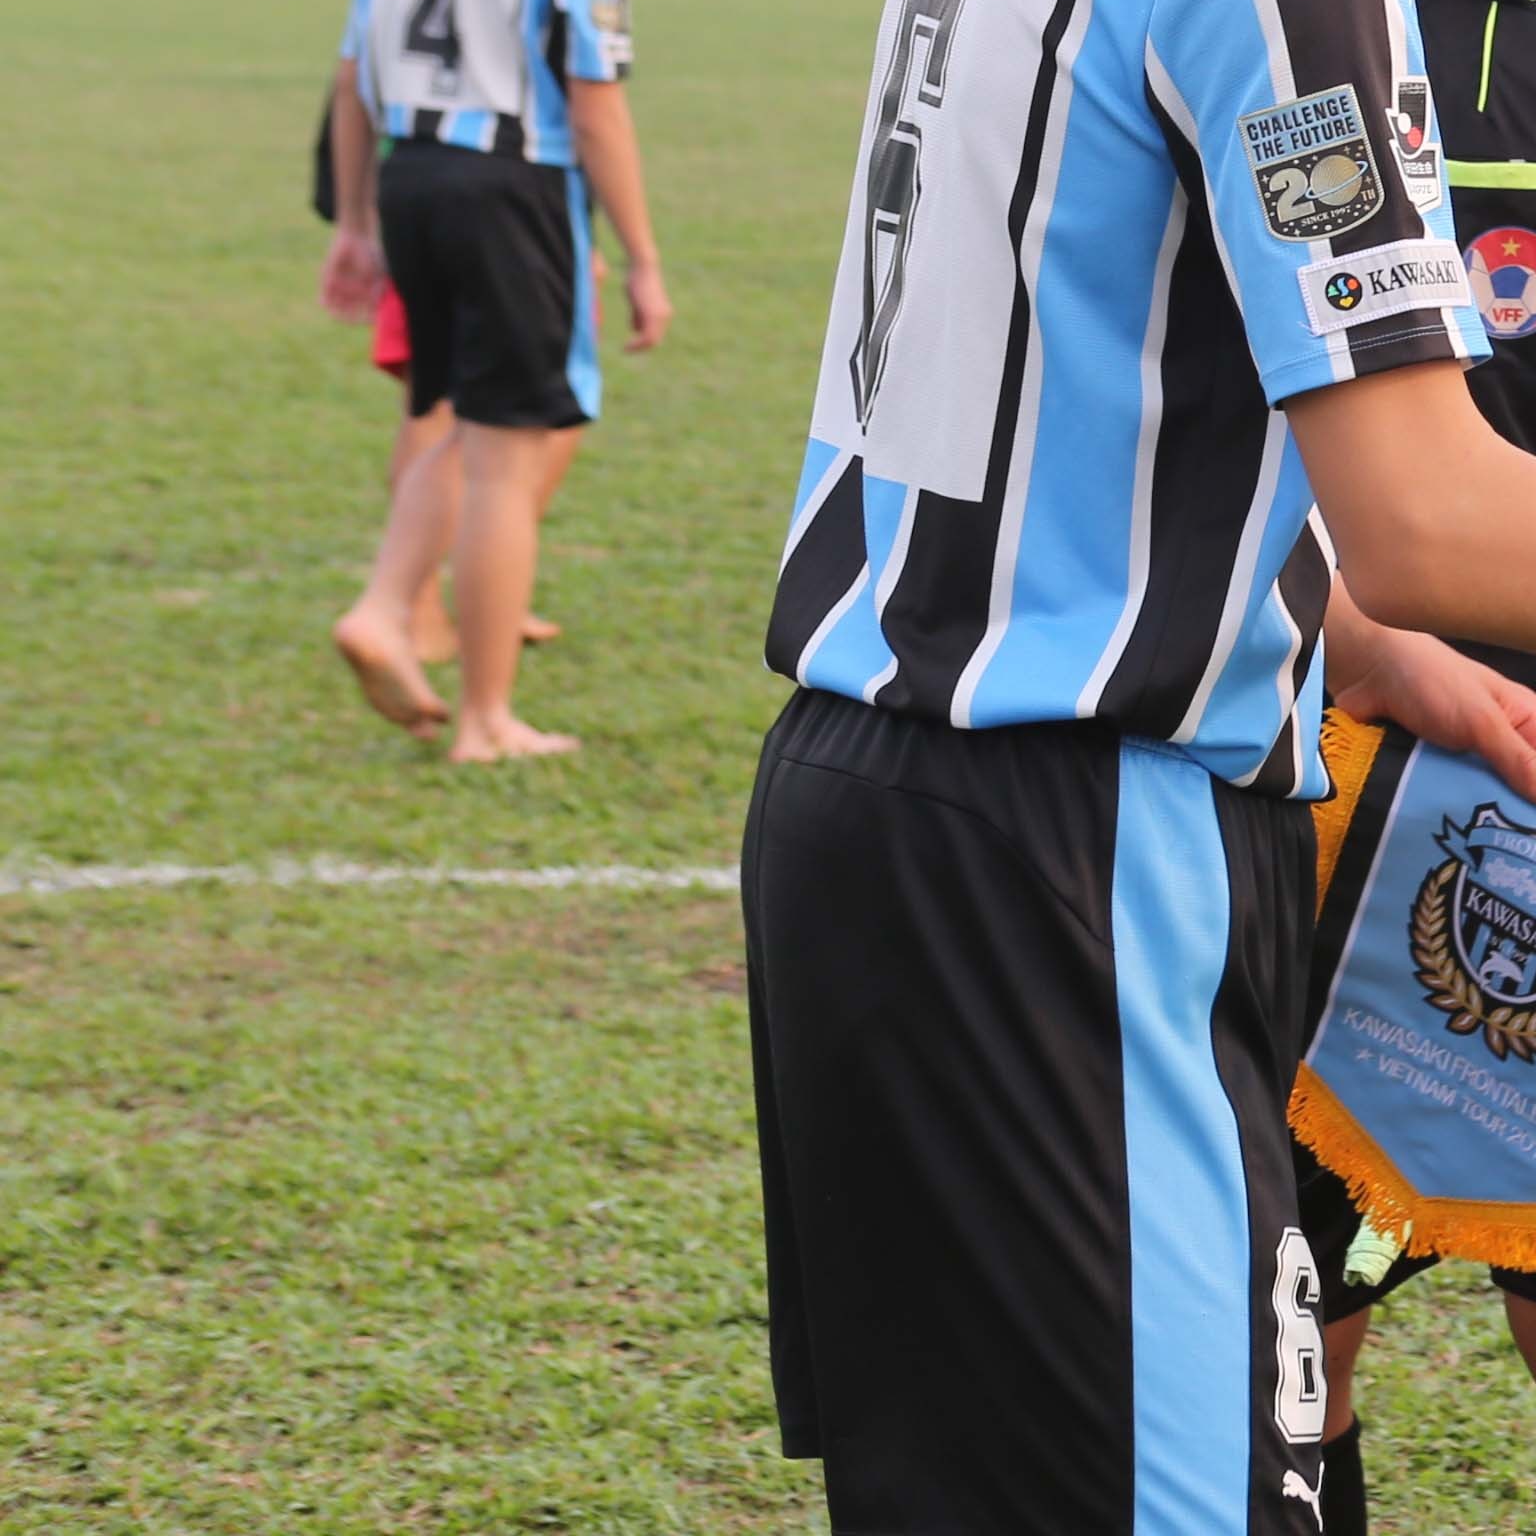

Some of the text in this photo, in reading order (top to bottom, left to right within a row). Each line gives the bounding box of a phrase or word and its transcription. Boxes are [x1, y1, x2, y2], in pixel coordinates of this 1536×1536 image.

[1246, 94, 1351, 142] CHALLENGE
[1252, 116, 1357, 162] THE FUTURE
[1301, 205, 1351, 227] SINCE 1997
[1361, 190, 1376, 202] TH
[1368, 260, 1458, 296] KAWASAKI
[1492, 306, 1524, 323] VFF
[1342, 1007, 1451, 1071] KAWASAKI
[1376, 1053, 1458, 1107] VIETNAM
[1459, 1095, 1508, 1138] TOUR
[1271, 1226, 1328, 1444] 6
